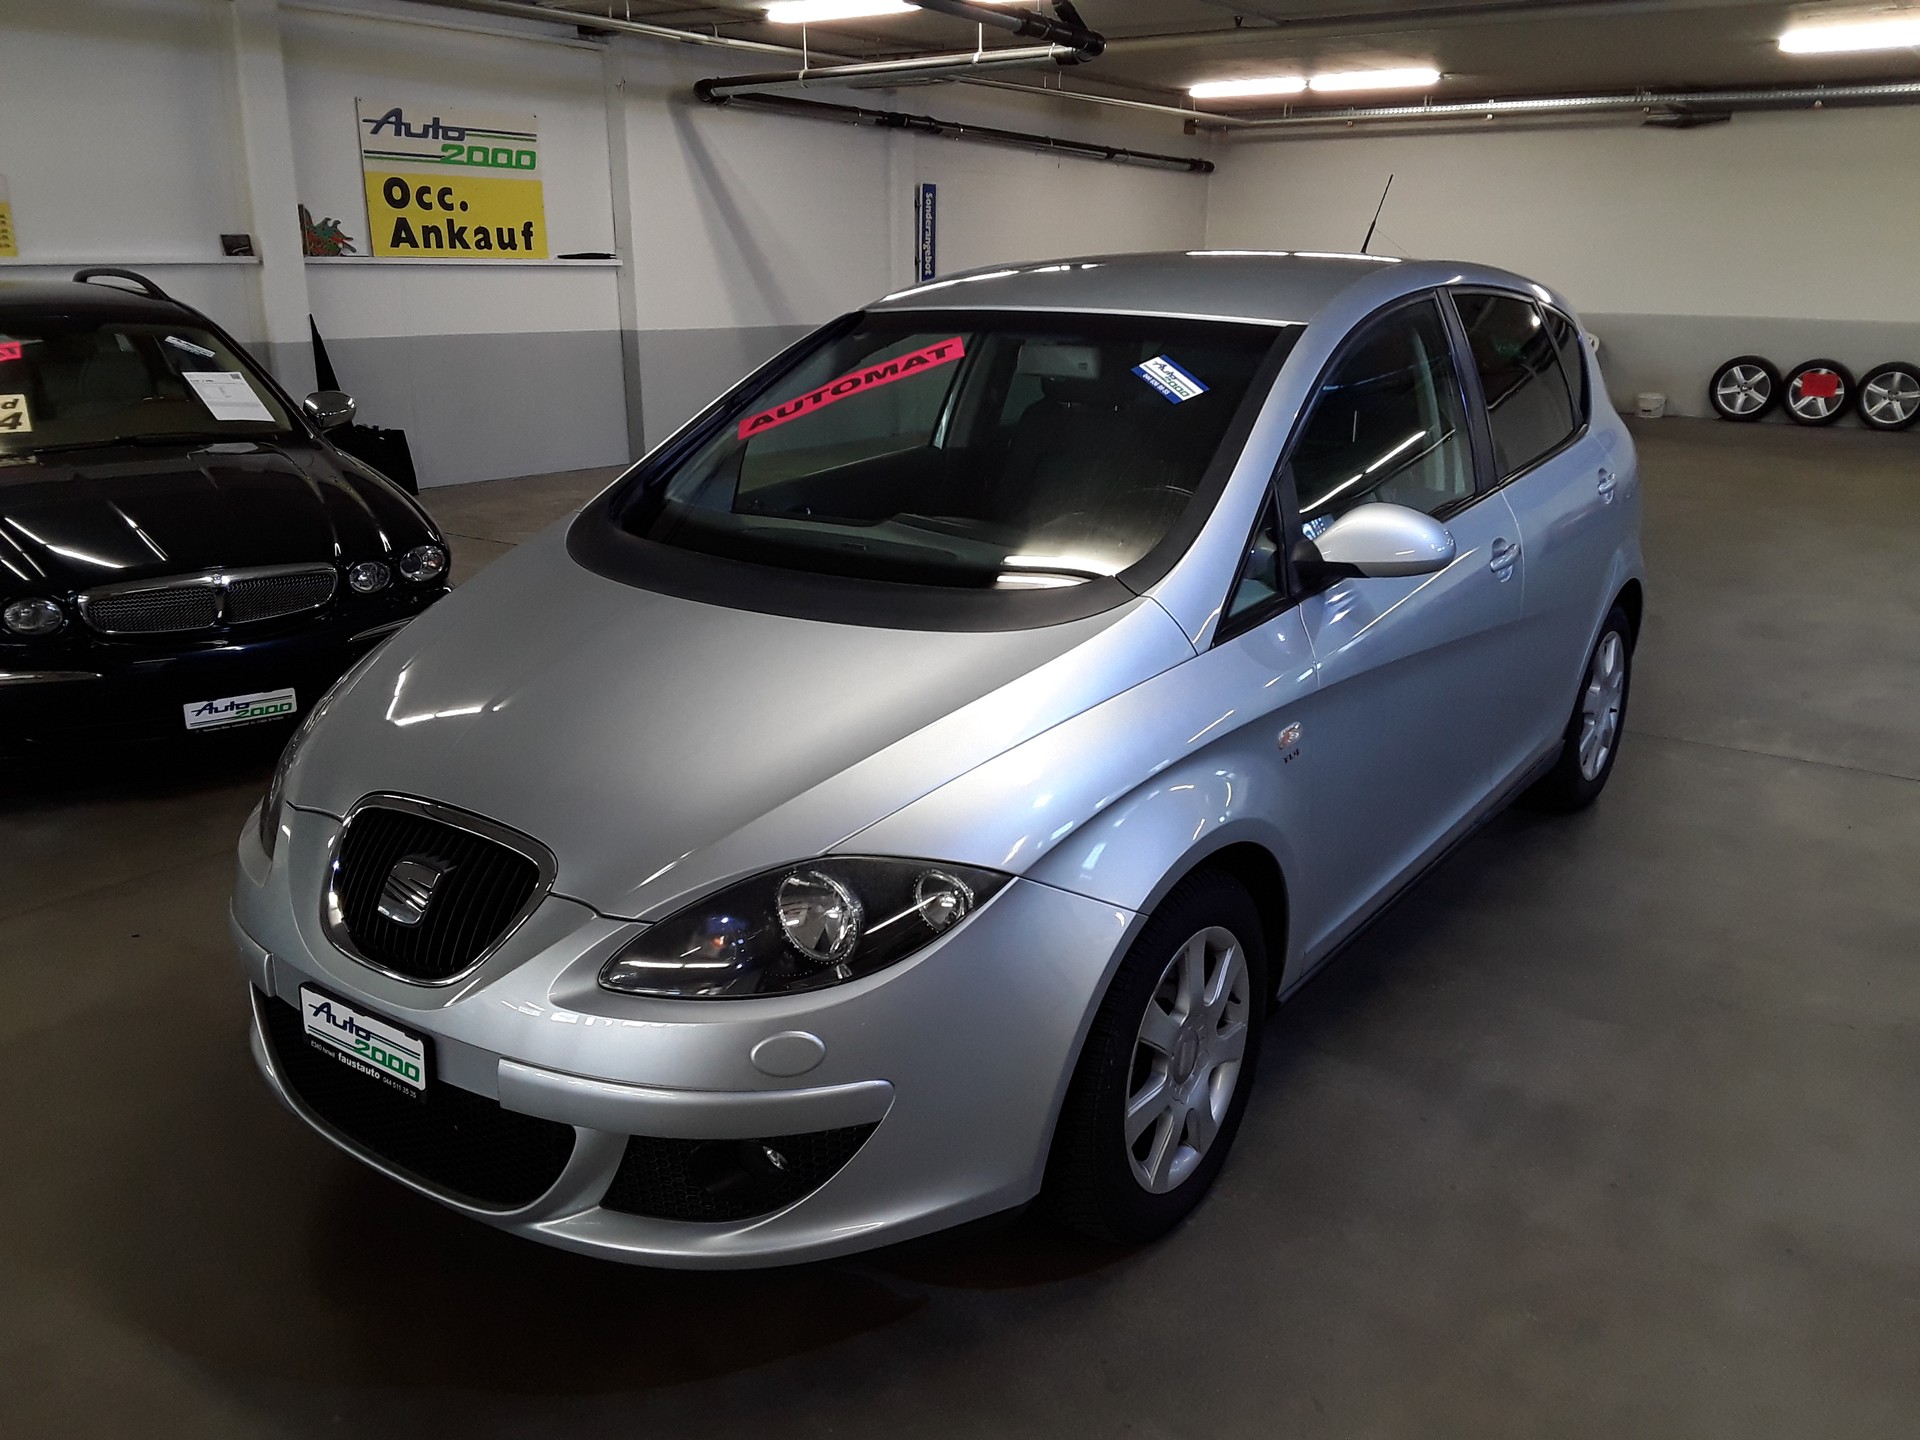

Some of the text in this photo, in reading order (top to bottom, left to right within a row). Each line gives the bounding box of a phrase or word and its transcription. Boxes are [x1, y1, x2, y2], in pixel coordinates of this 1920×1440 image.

[363, 107, 467, 142] Auto
[440, 143, 537, 170] 2000
[382, 176, 469, 212] Occ.
[389, 216, 534, 251] Ankauf
[1152, 360, 1177, 380] Auto
[748, 344, 953, 431] AUTOMAT
[1165, 376, 1190, 397] 2000
[191, 701, 250, 717] Auto
[235, 702, 292, 719] 2000
[308, 1002, 372, 1041] Auto
[338, 1052, 380, 1079] faustauto
[354, 1038, 420, 1083] 2000
